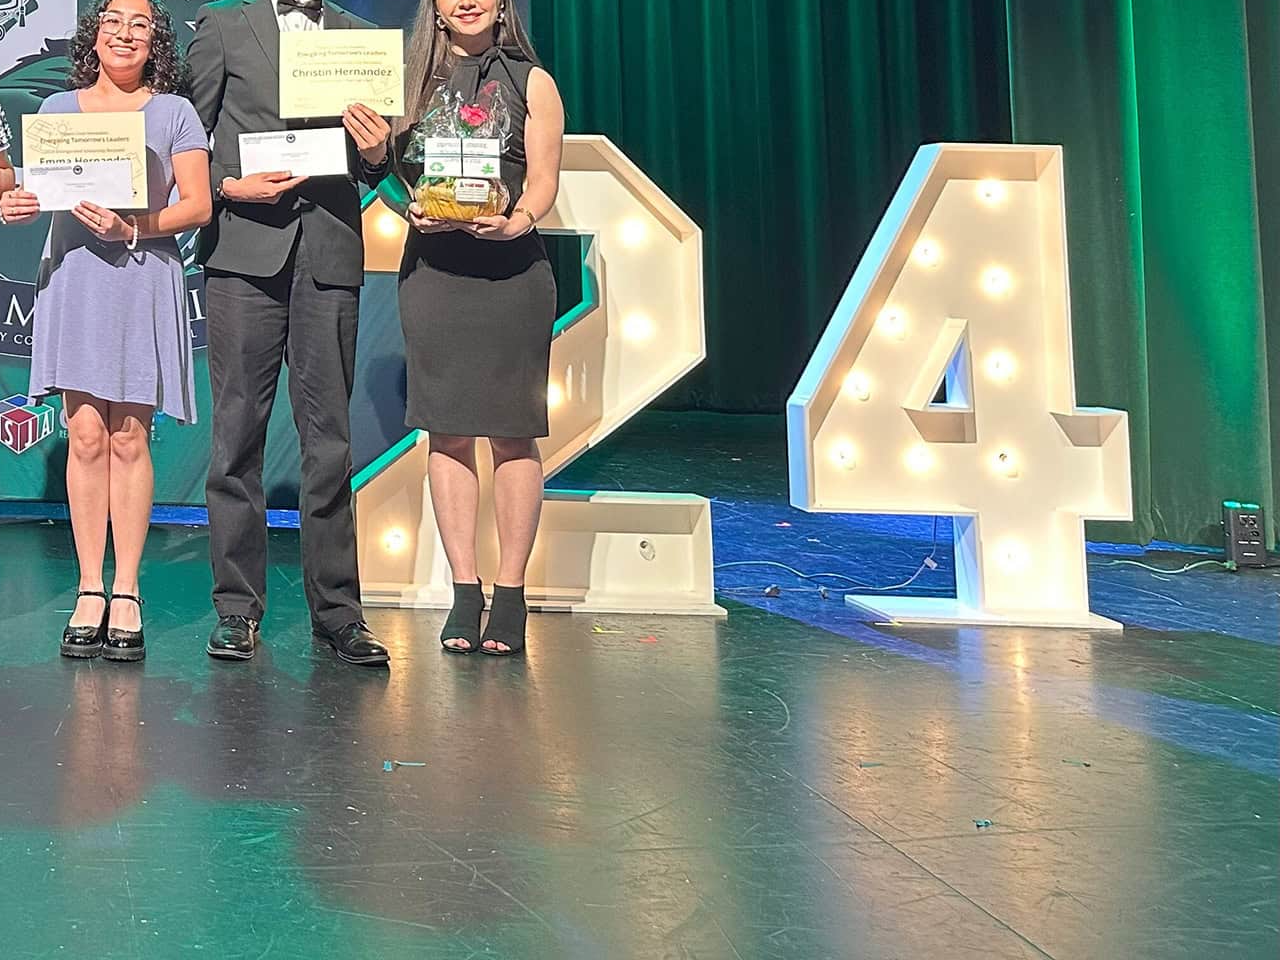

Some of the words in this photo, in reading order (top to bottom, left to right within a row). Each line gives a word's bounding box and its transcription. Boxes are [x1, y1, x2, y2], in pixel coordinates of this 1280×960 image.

[292, 68, 332, 78] Christin
[335, 67, 392, 77] Hernandez
[40, 157, 72, 165] Emma
